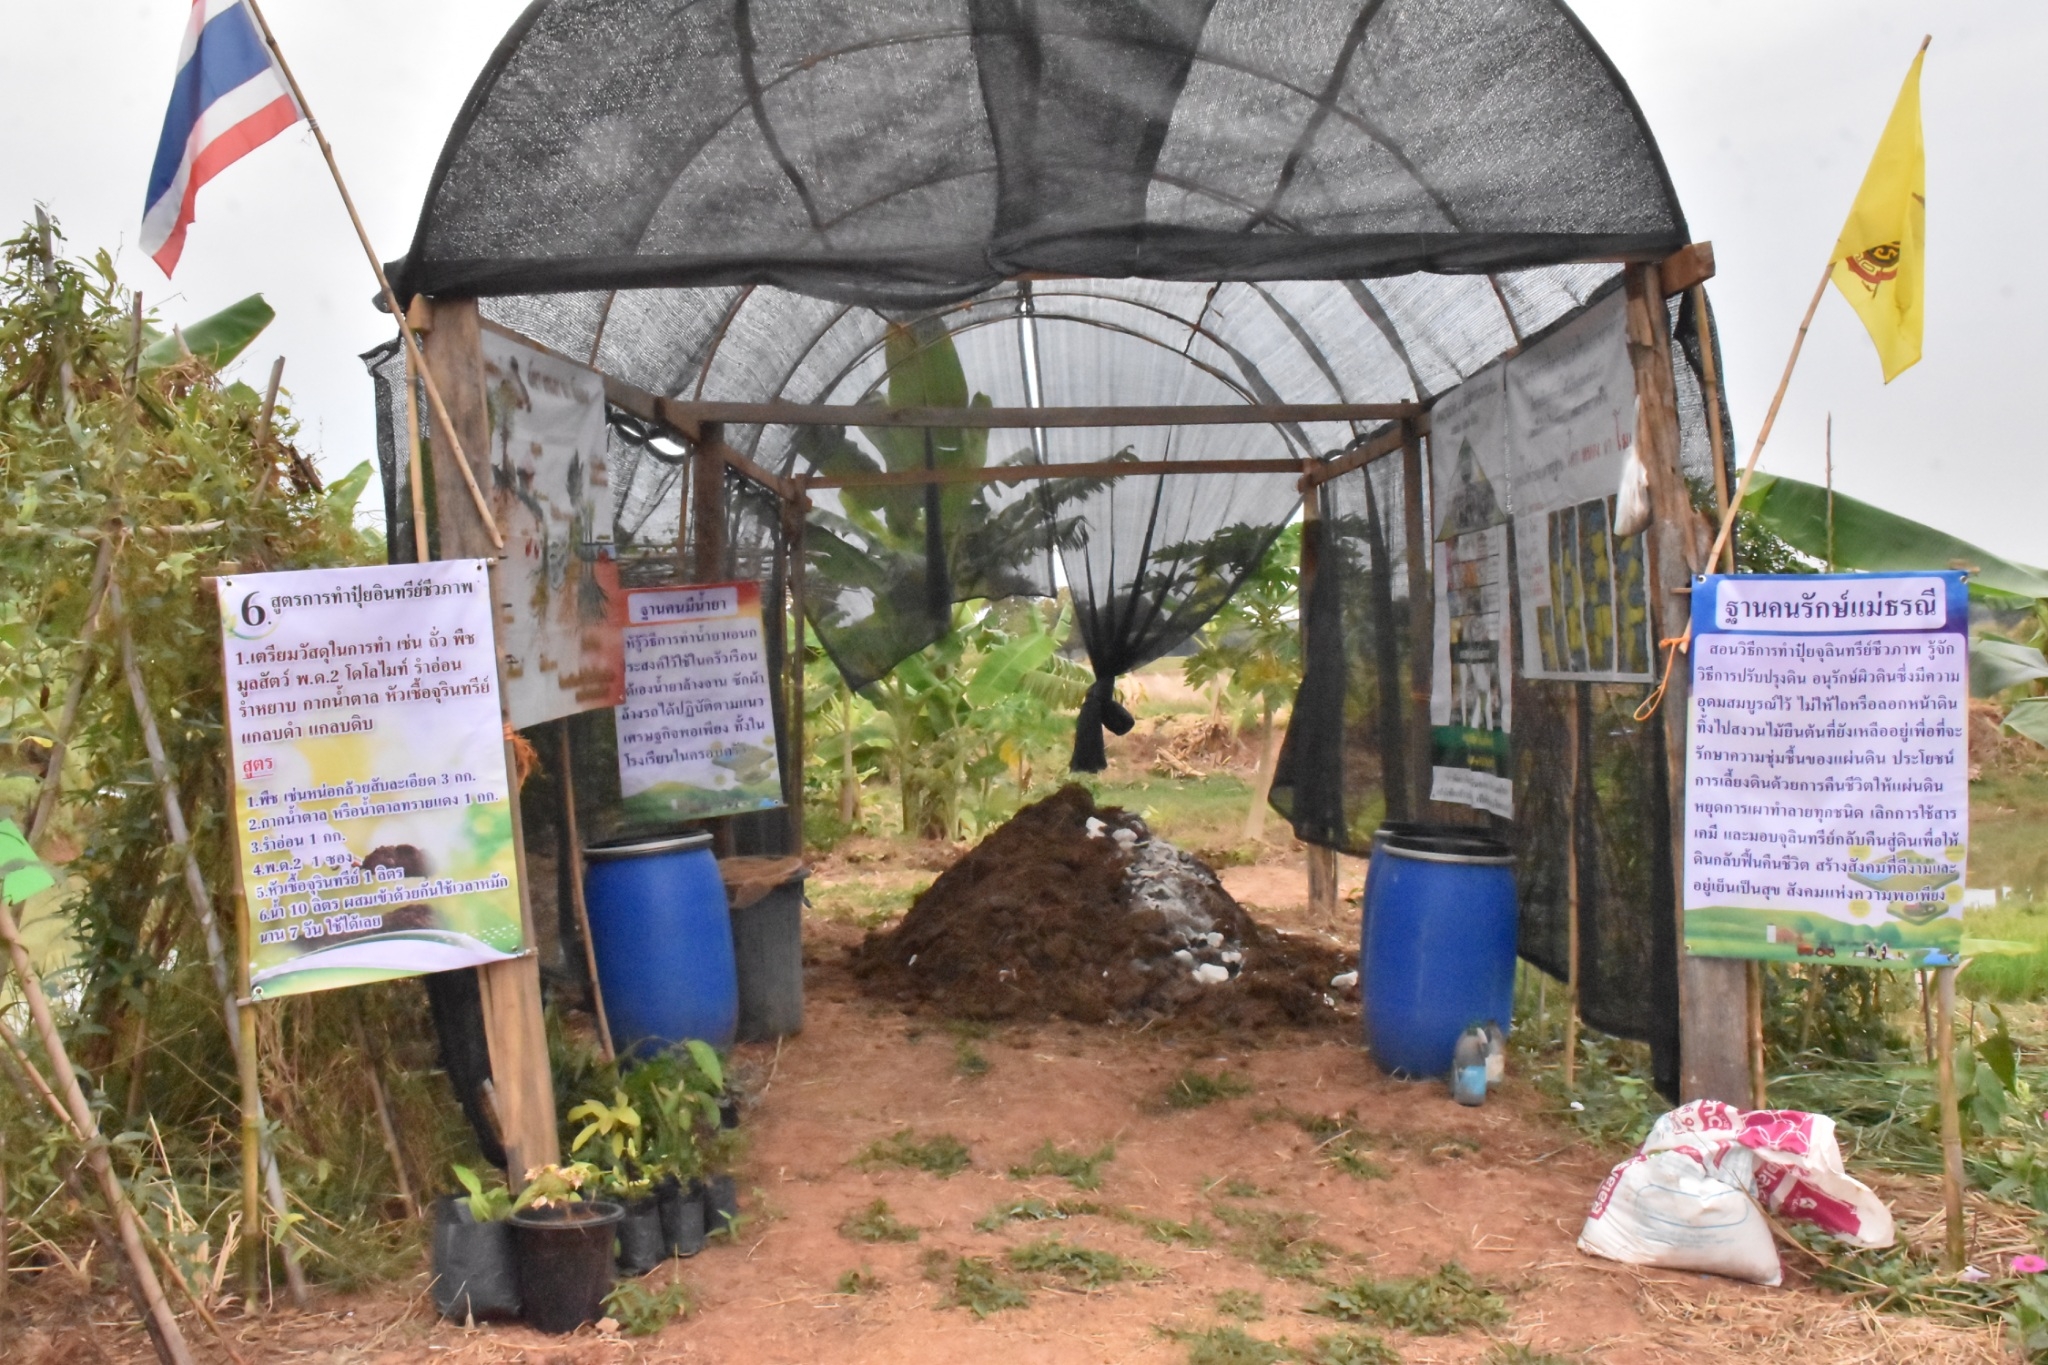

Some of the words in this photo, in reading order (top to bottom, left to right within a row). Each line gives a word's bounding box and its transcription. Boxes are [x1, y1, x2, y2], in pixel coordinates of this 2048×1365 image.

[271, 579, 473, 614] สูตรการทำปุ๋ยอินทรีย์ชีวภาพ
[1725, 588, 1936, 625] ฐานคนรักษ์แม่ธรณี
[397, 633, 422, 651] เช่น
[429, 626, 447, 648] ถั่ว
[453, 628, 475, 645] พืช
[1928, 640, 1954, 660] รู้จัก
[237, 669, 290, 699] มูลสัตว์
[346, 659, 408, 681] โดโลไมท์
[414, 656, 462, 675] รำอ่อน
[239, 697, 296, 718] รำหยาบ
[303, 685, 379, 711] กากน้ำตาล
[242, 722, 302, 744] แกลบดำ
[309, 715, 373, 736] แกลบดิบ
[242, 757, 273, 780] สูตร
[290, 902, 308, 917] 10
[289, 927, 299, 941] 7
